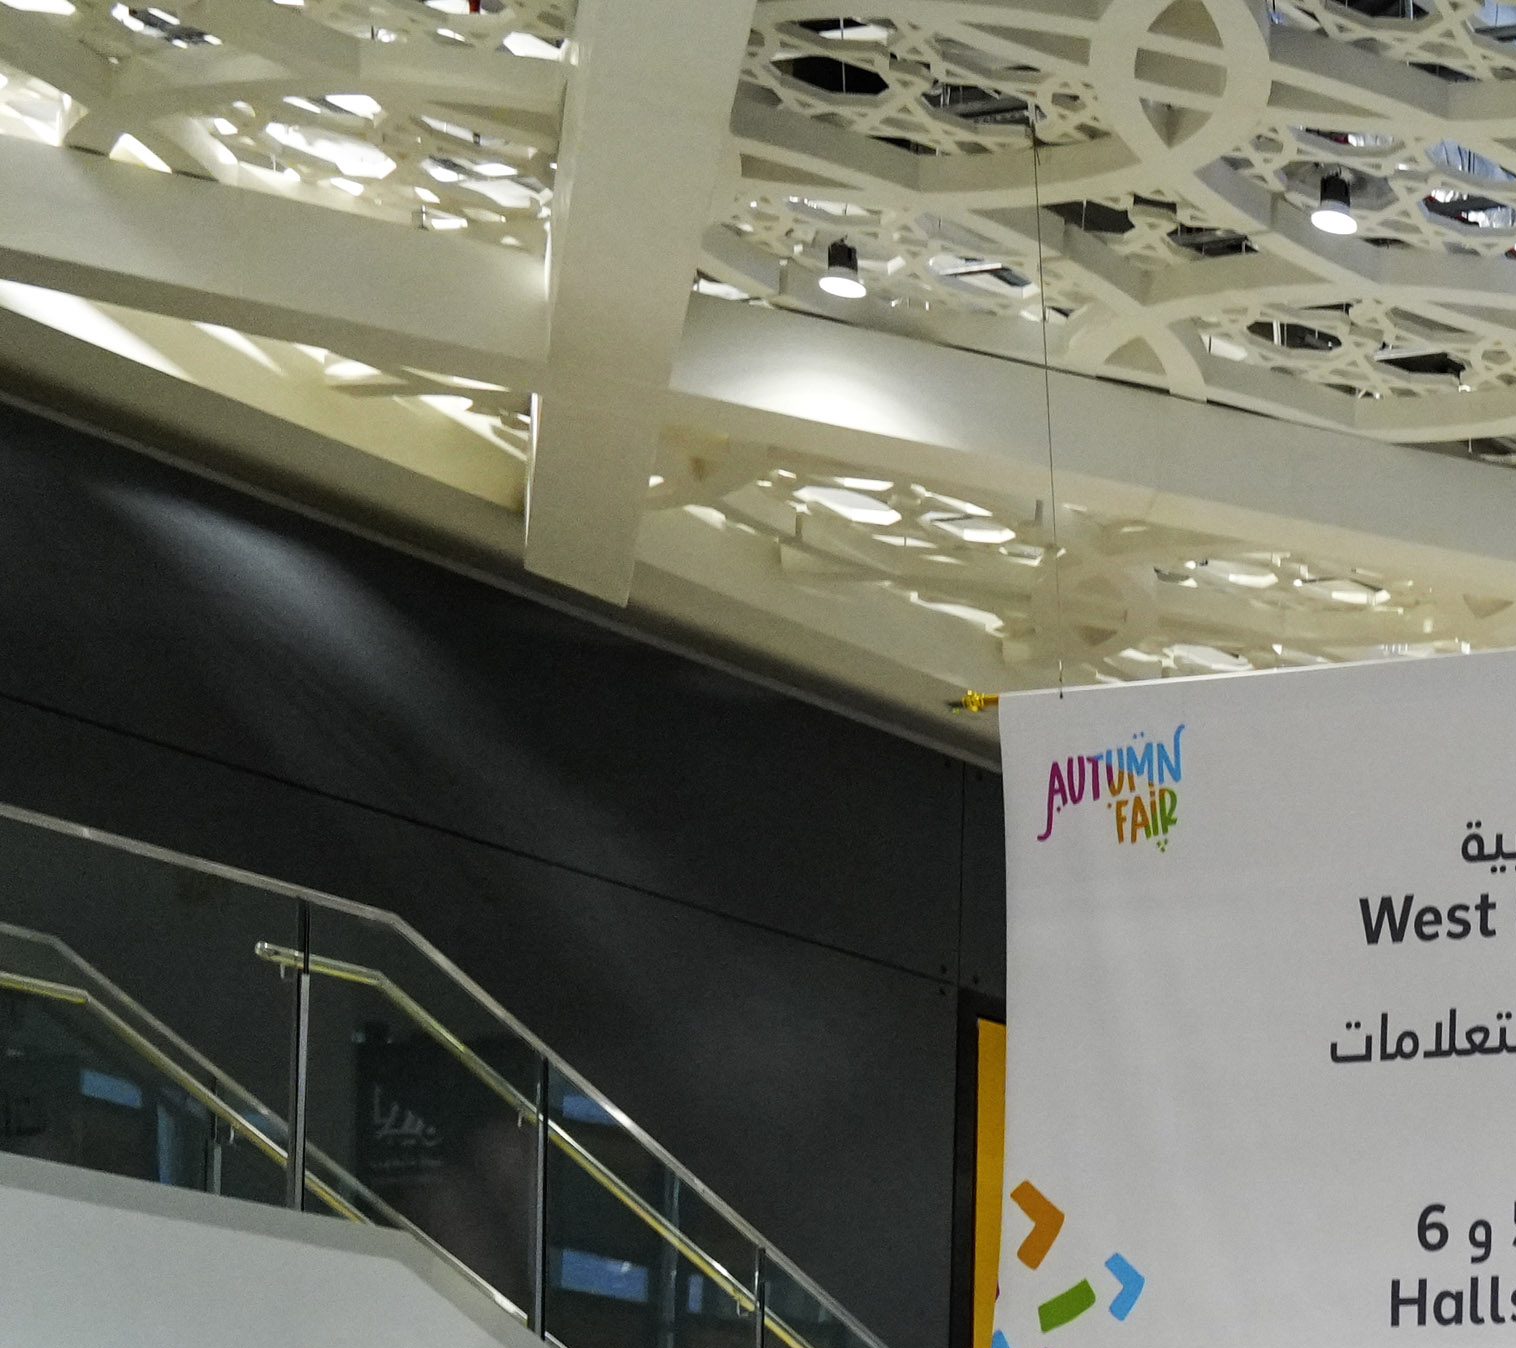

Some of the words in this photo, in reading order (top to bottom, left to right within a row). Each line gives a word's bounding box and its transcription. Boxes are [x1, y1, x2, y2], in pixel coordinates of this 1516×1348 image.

[1037, 724, 1185, 842] AUTUMN
[1359, 893, 1497, 945] West
[1416, 1204, 1449, 1252] 6
[1468, 1218, 1492, 1264] و
